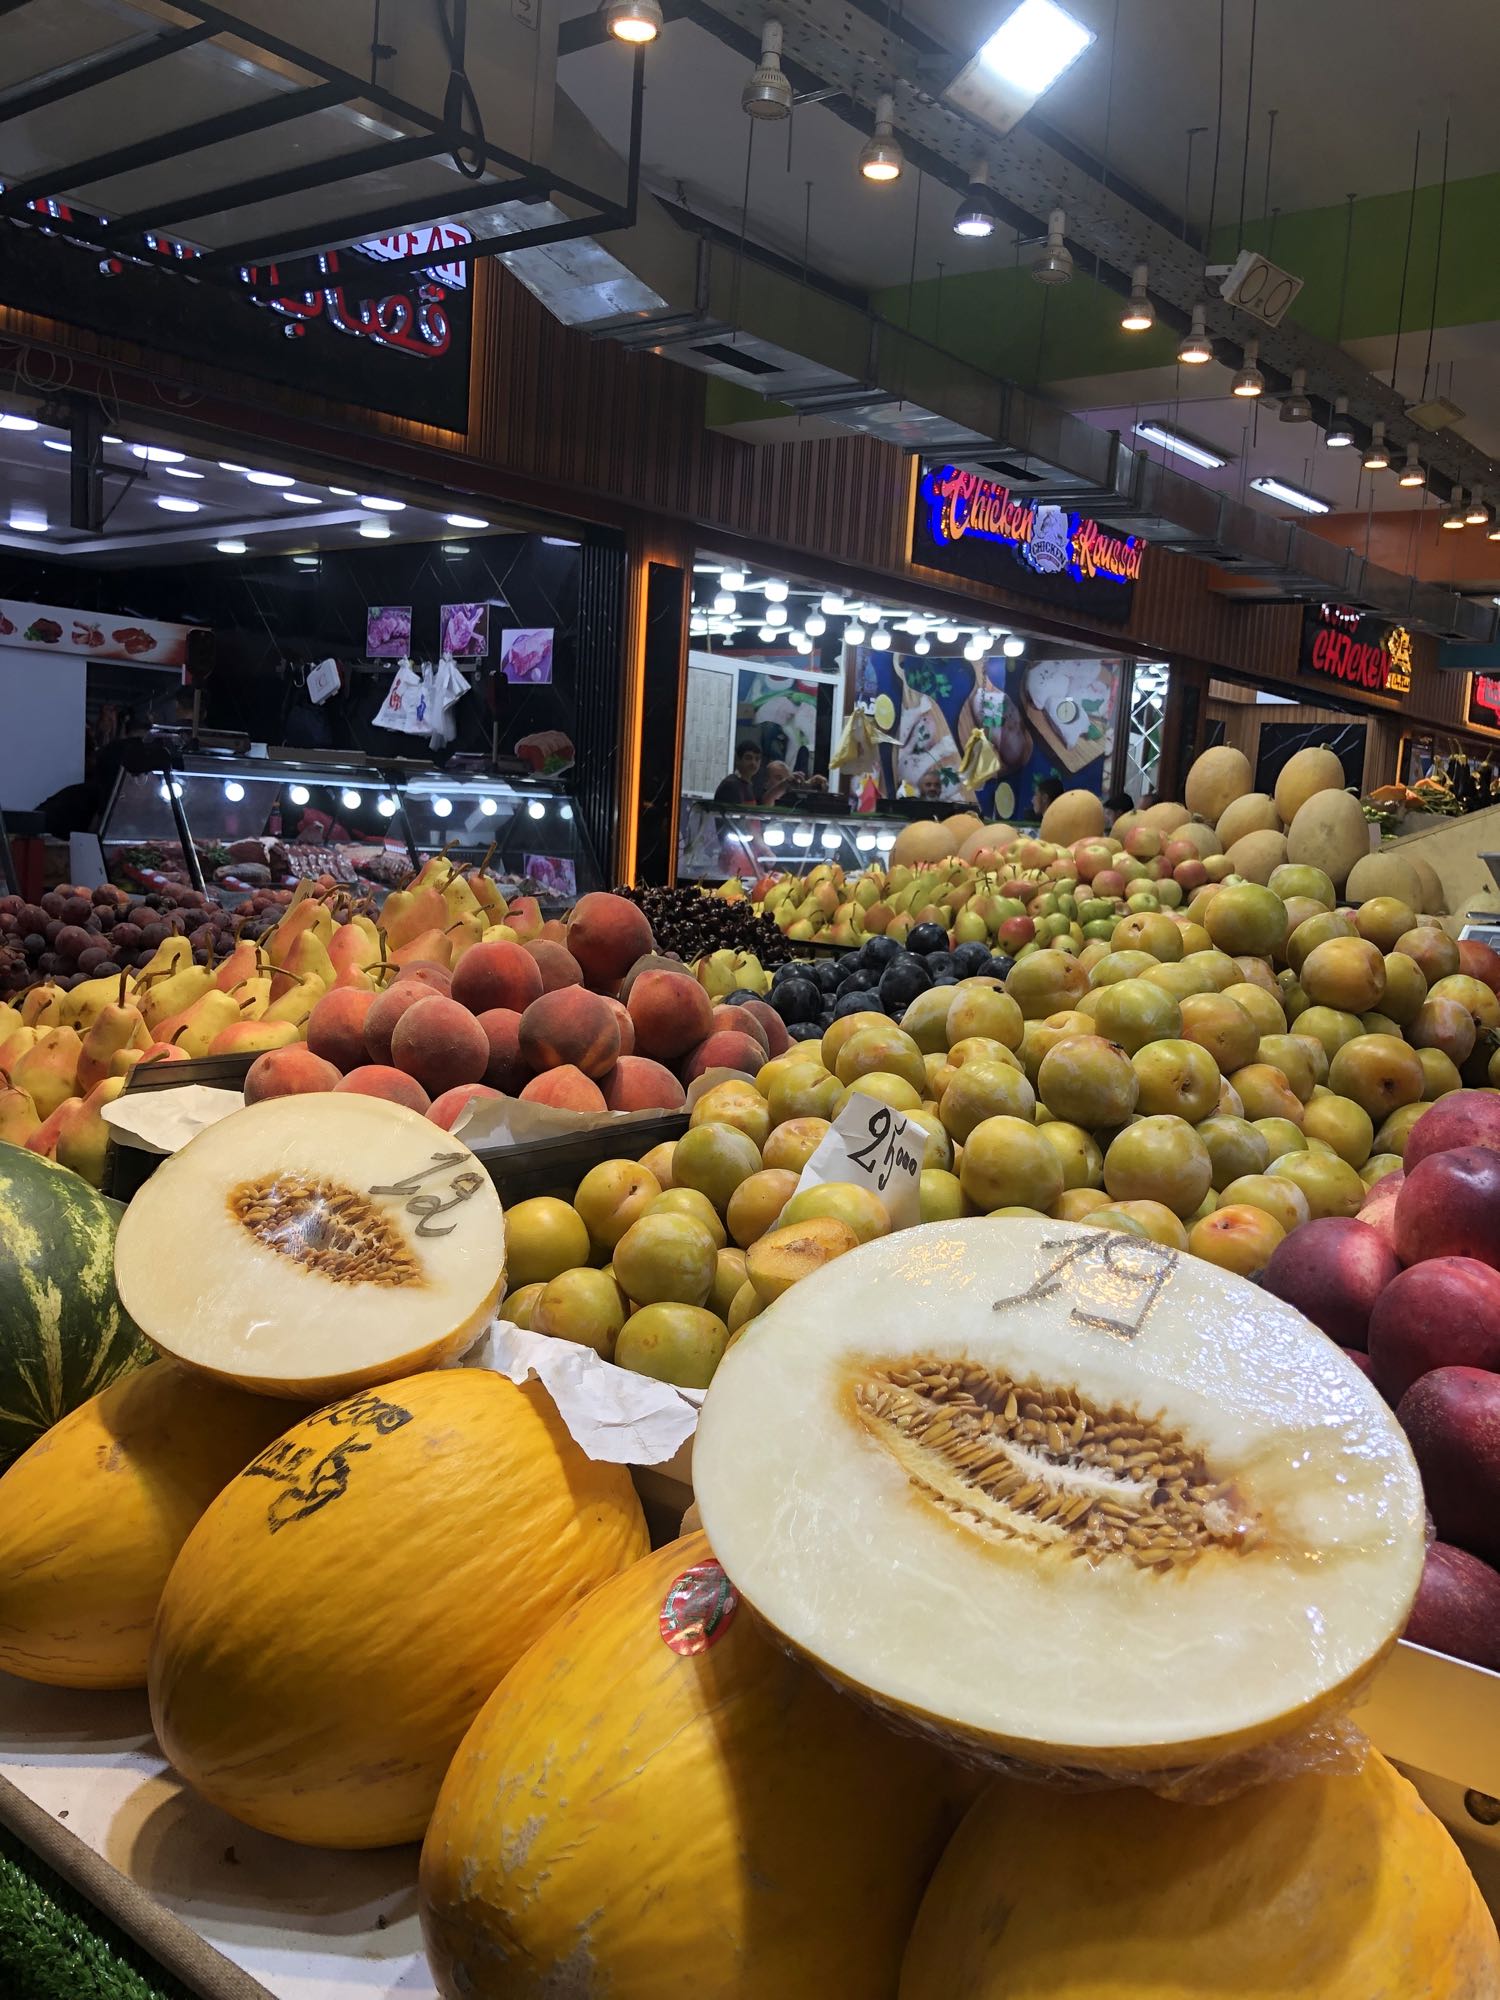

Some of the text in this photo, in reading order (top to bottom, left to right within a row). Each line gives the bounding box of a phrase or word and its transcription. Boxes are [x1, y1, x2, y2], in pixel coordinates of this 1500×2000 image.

[941, 469, 1034, 543] Chicken
[1032, 540, 1068, 566] CHICKEN
[1312, 629, 1392, 690] CHICKEN
